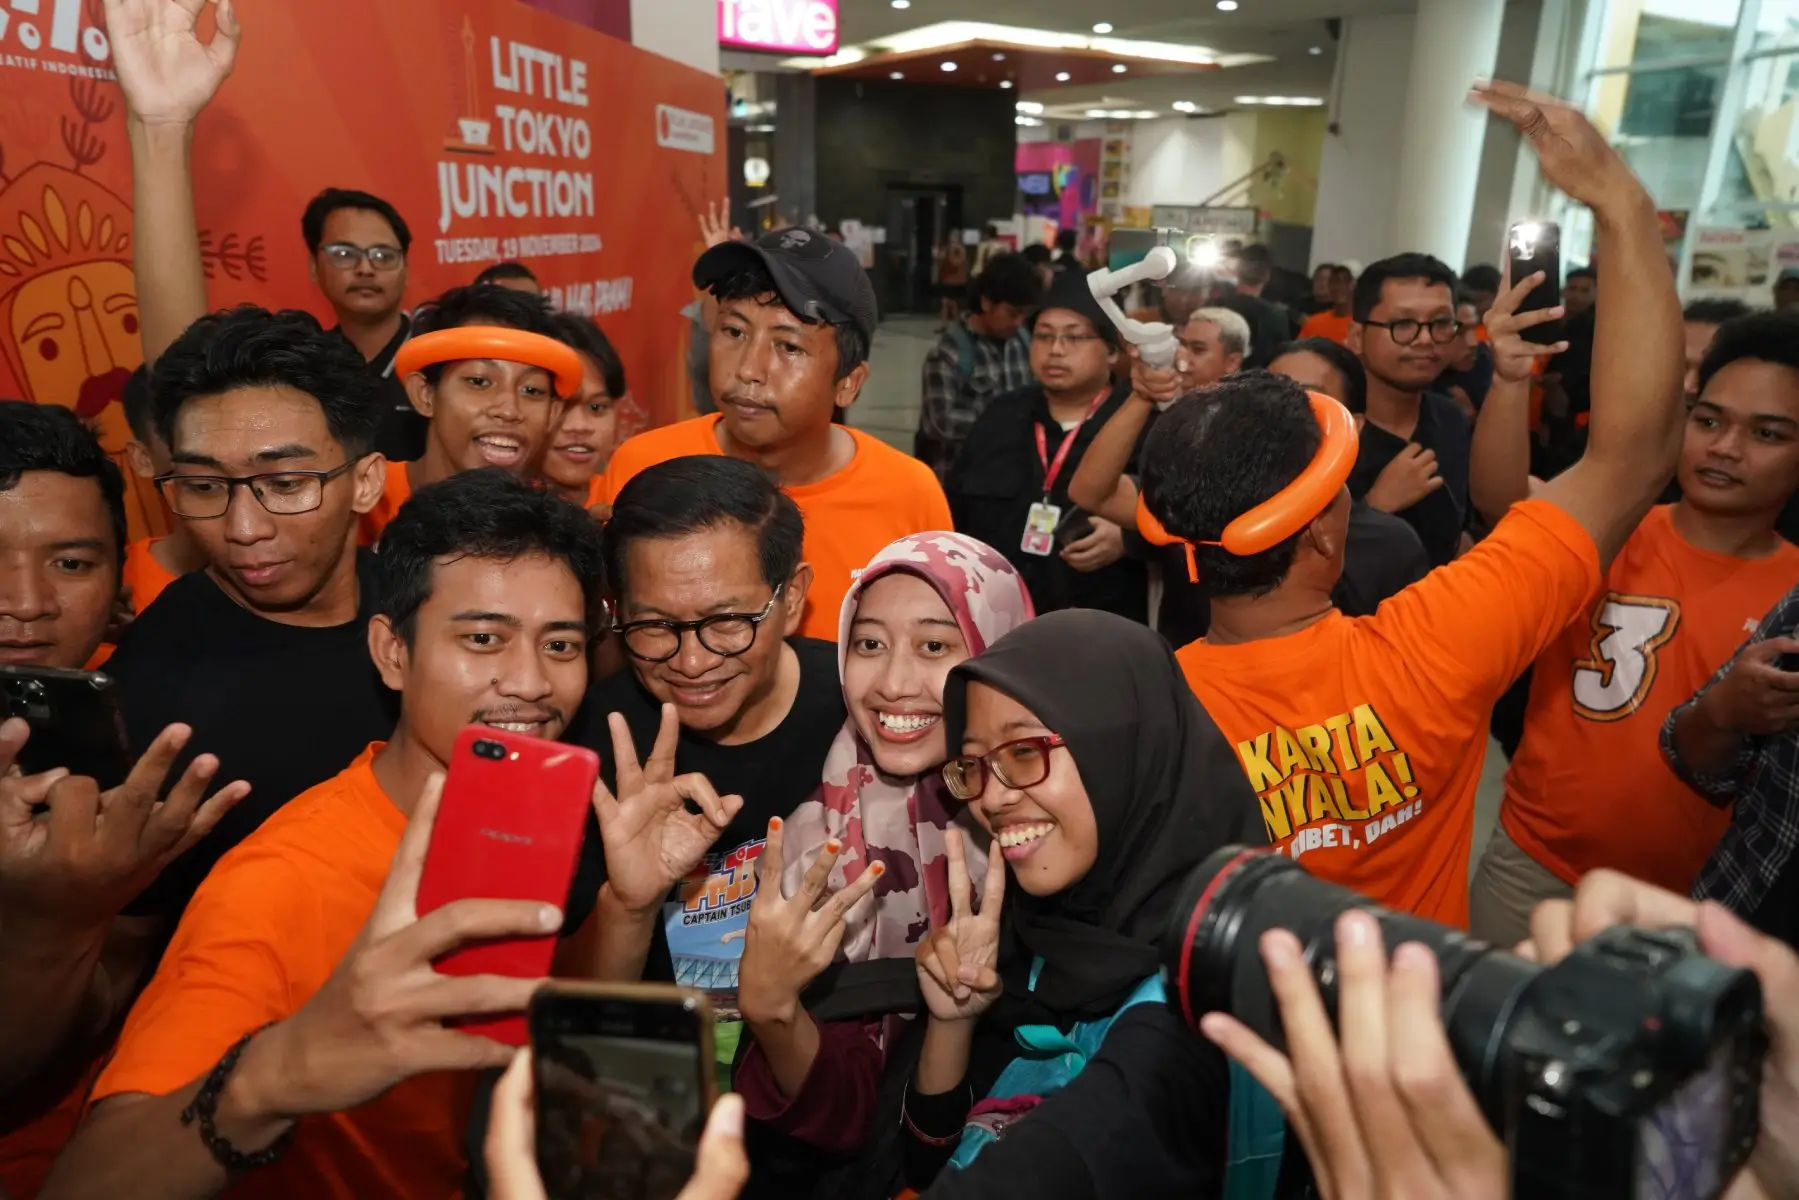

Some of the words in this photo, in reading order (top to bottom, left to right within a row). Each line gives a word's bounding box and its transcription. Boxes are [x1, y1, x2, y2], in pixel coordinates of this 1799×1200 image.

[41, 60, 118, 80] INDONESIA
[490, 35, 588, 107] LITTLE
[495, 104, 591, 159] TOKYO
[437, 161, 594, 234] JUNCTION
[1571, 591, 1680, 722] 3
[1364, 799, 1423, 844] DAH!
[683, 908, 727, 926] CAPTAIN
